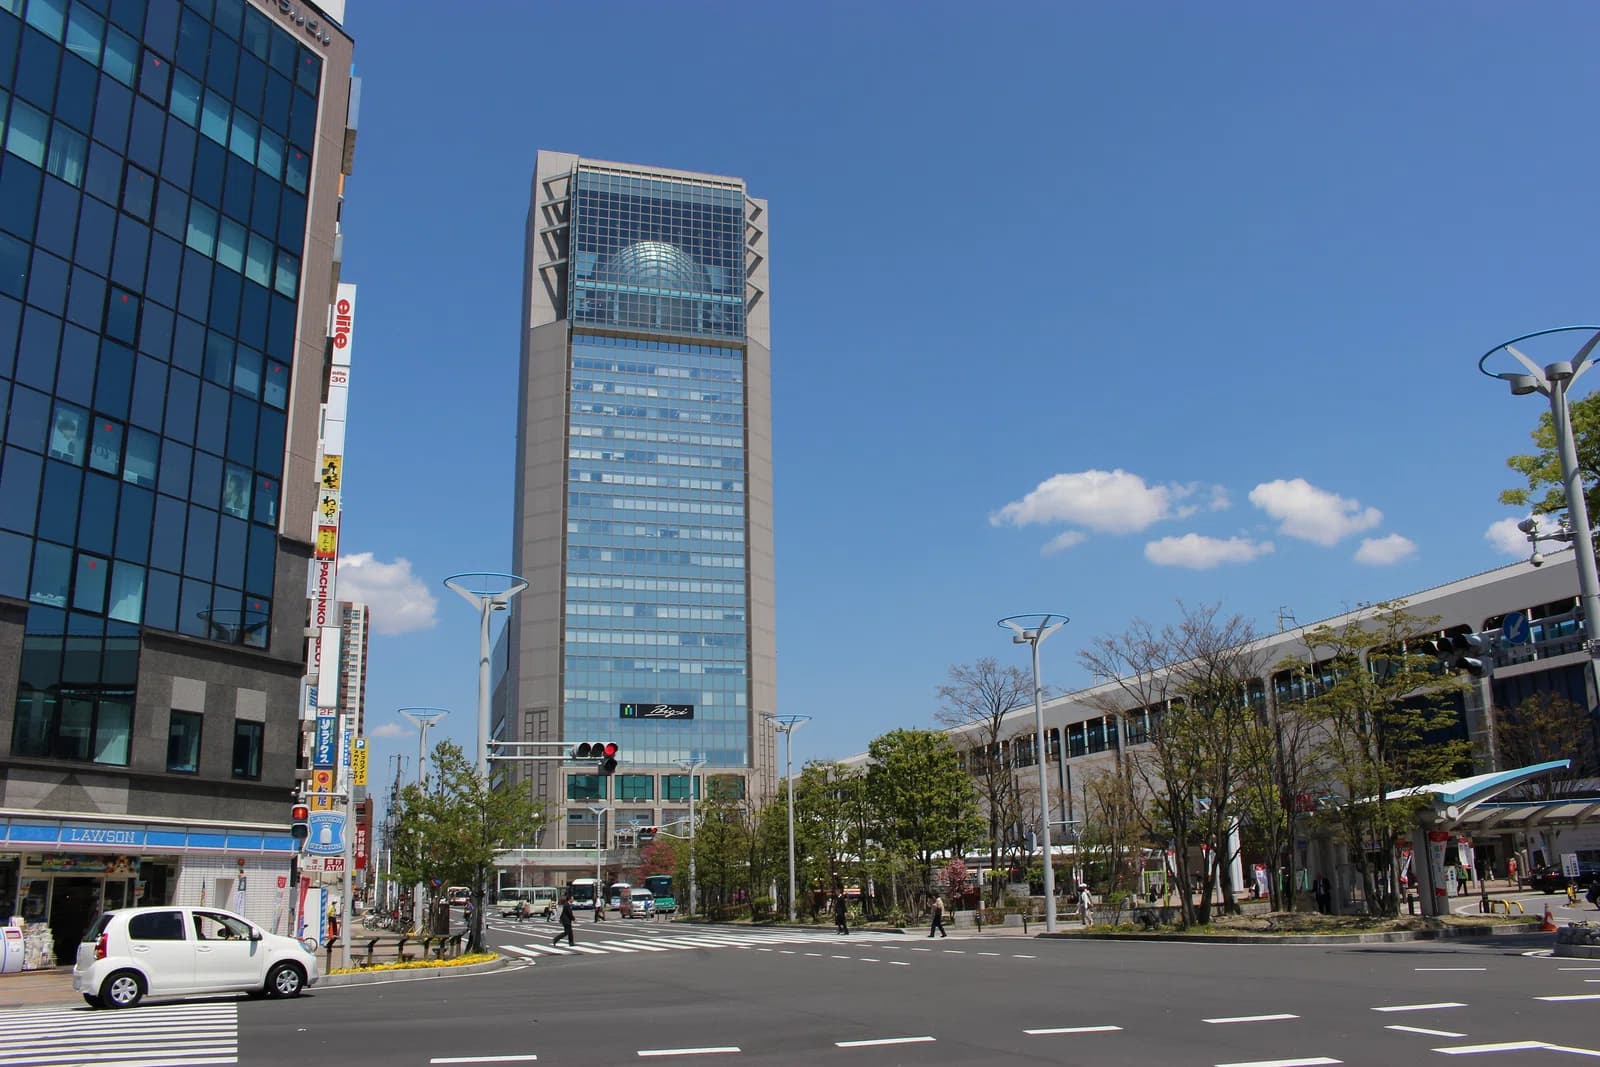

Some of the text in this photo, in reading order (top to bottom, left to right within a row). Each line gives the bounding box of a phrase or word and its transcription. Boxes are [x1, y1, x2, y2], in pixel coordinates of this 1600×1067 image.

[334, 299, 351, 349] elite
[331, 376, 346, 384] 30
[317, 562, 328, 624] PACHINKO
[319, 719, 331, 763] リラックス
[356, 740, 364, 748] P
[311, 816, 344, 824] LAWSON
[71, 828, 136, 844] LAWSON
